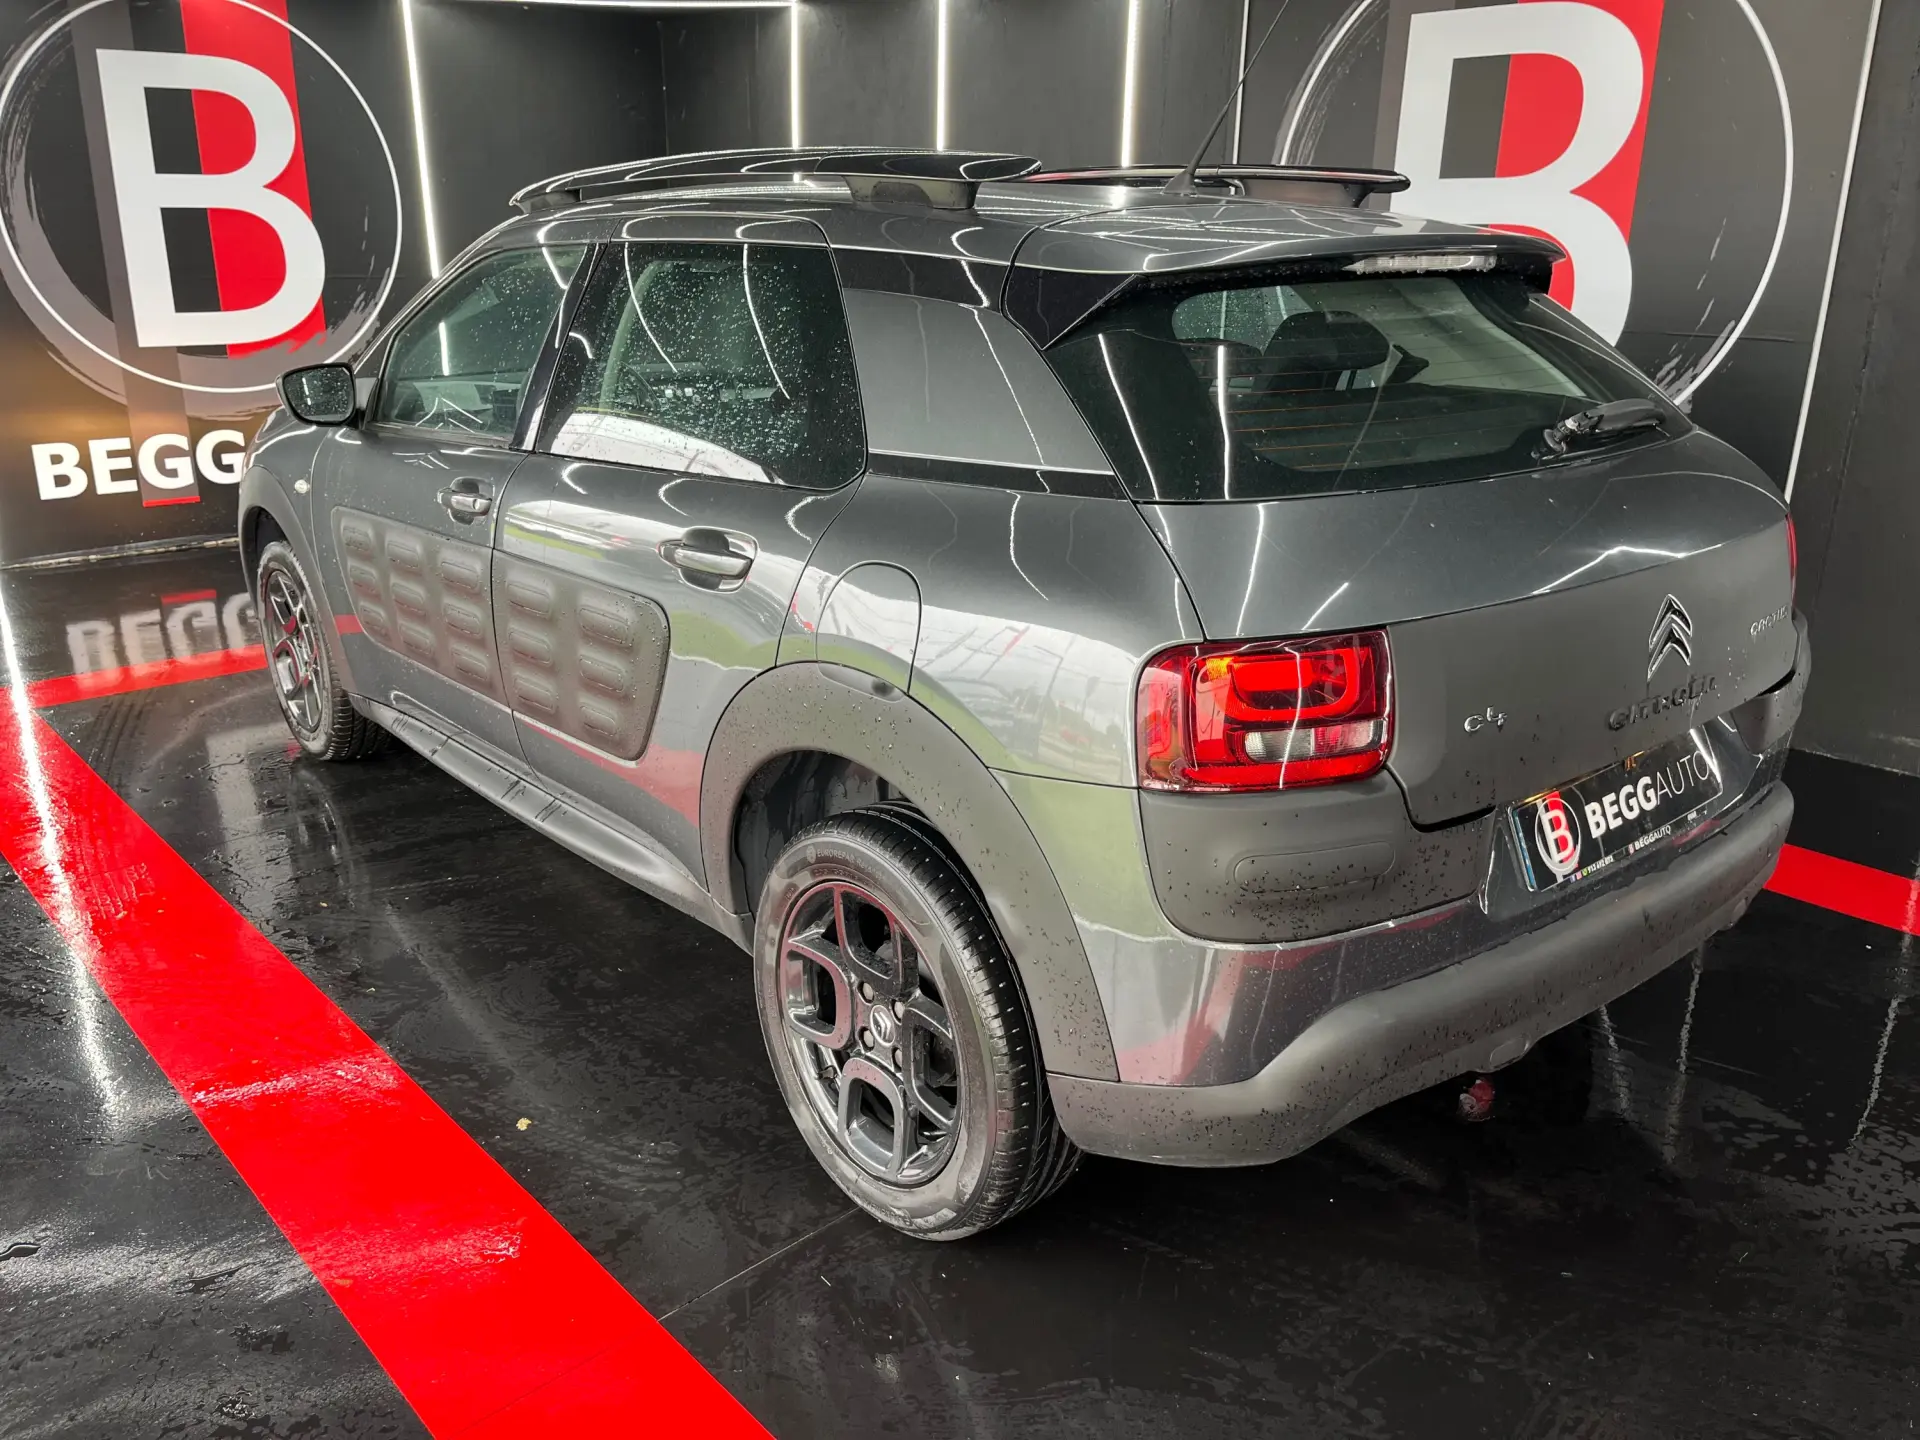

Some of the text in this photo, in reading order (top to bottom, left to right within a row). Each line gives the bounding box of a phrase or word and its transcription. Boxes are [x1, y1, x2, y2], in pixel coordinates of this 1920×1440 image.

[96, 48, 326, 348] B
[1390, 0, 1644, 347] B
[31, 430, 246, 500] BEGG
[1464, 706, 1507, 732] C4
[1584, 750, 1710, 839] BEGGAUTO
[1634, 825, 1671, 850] BEGGAUTO
